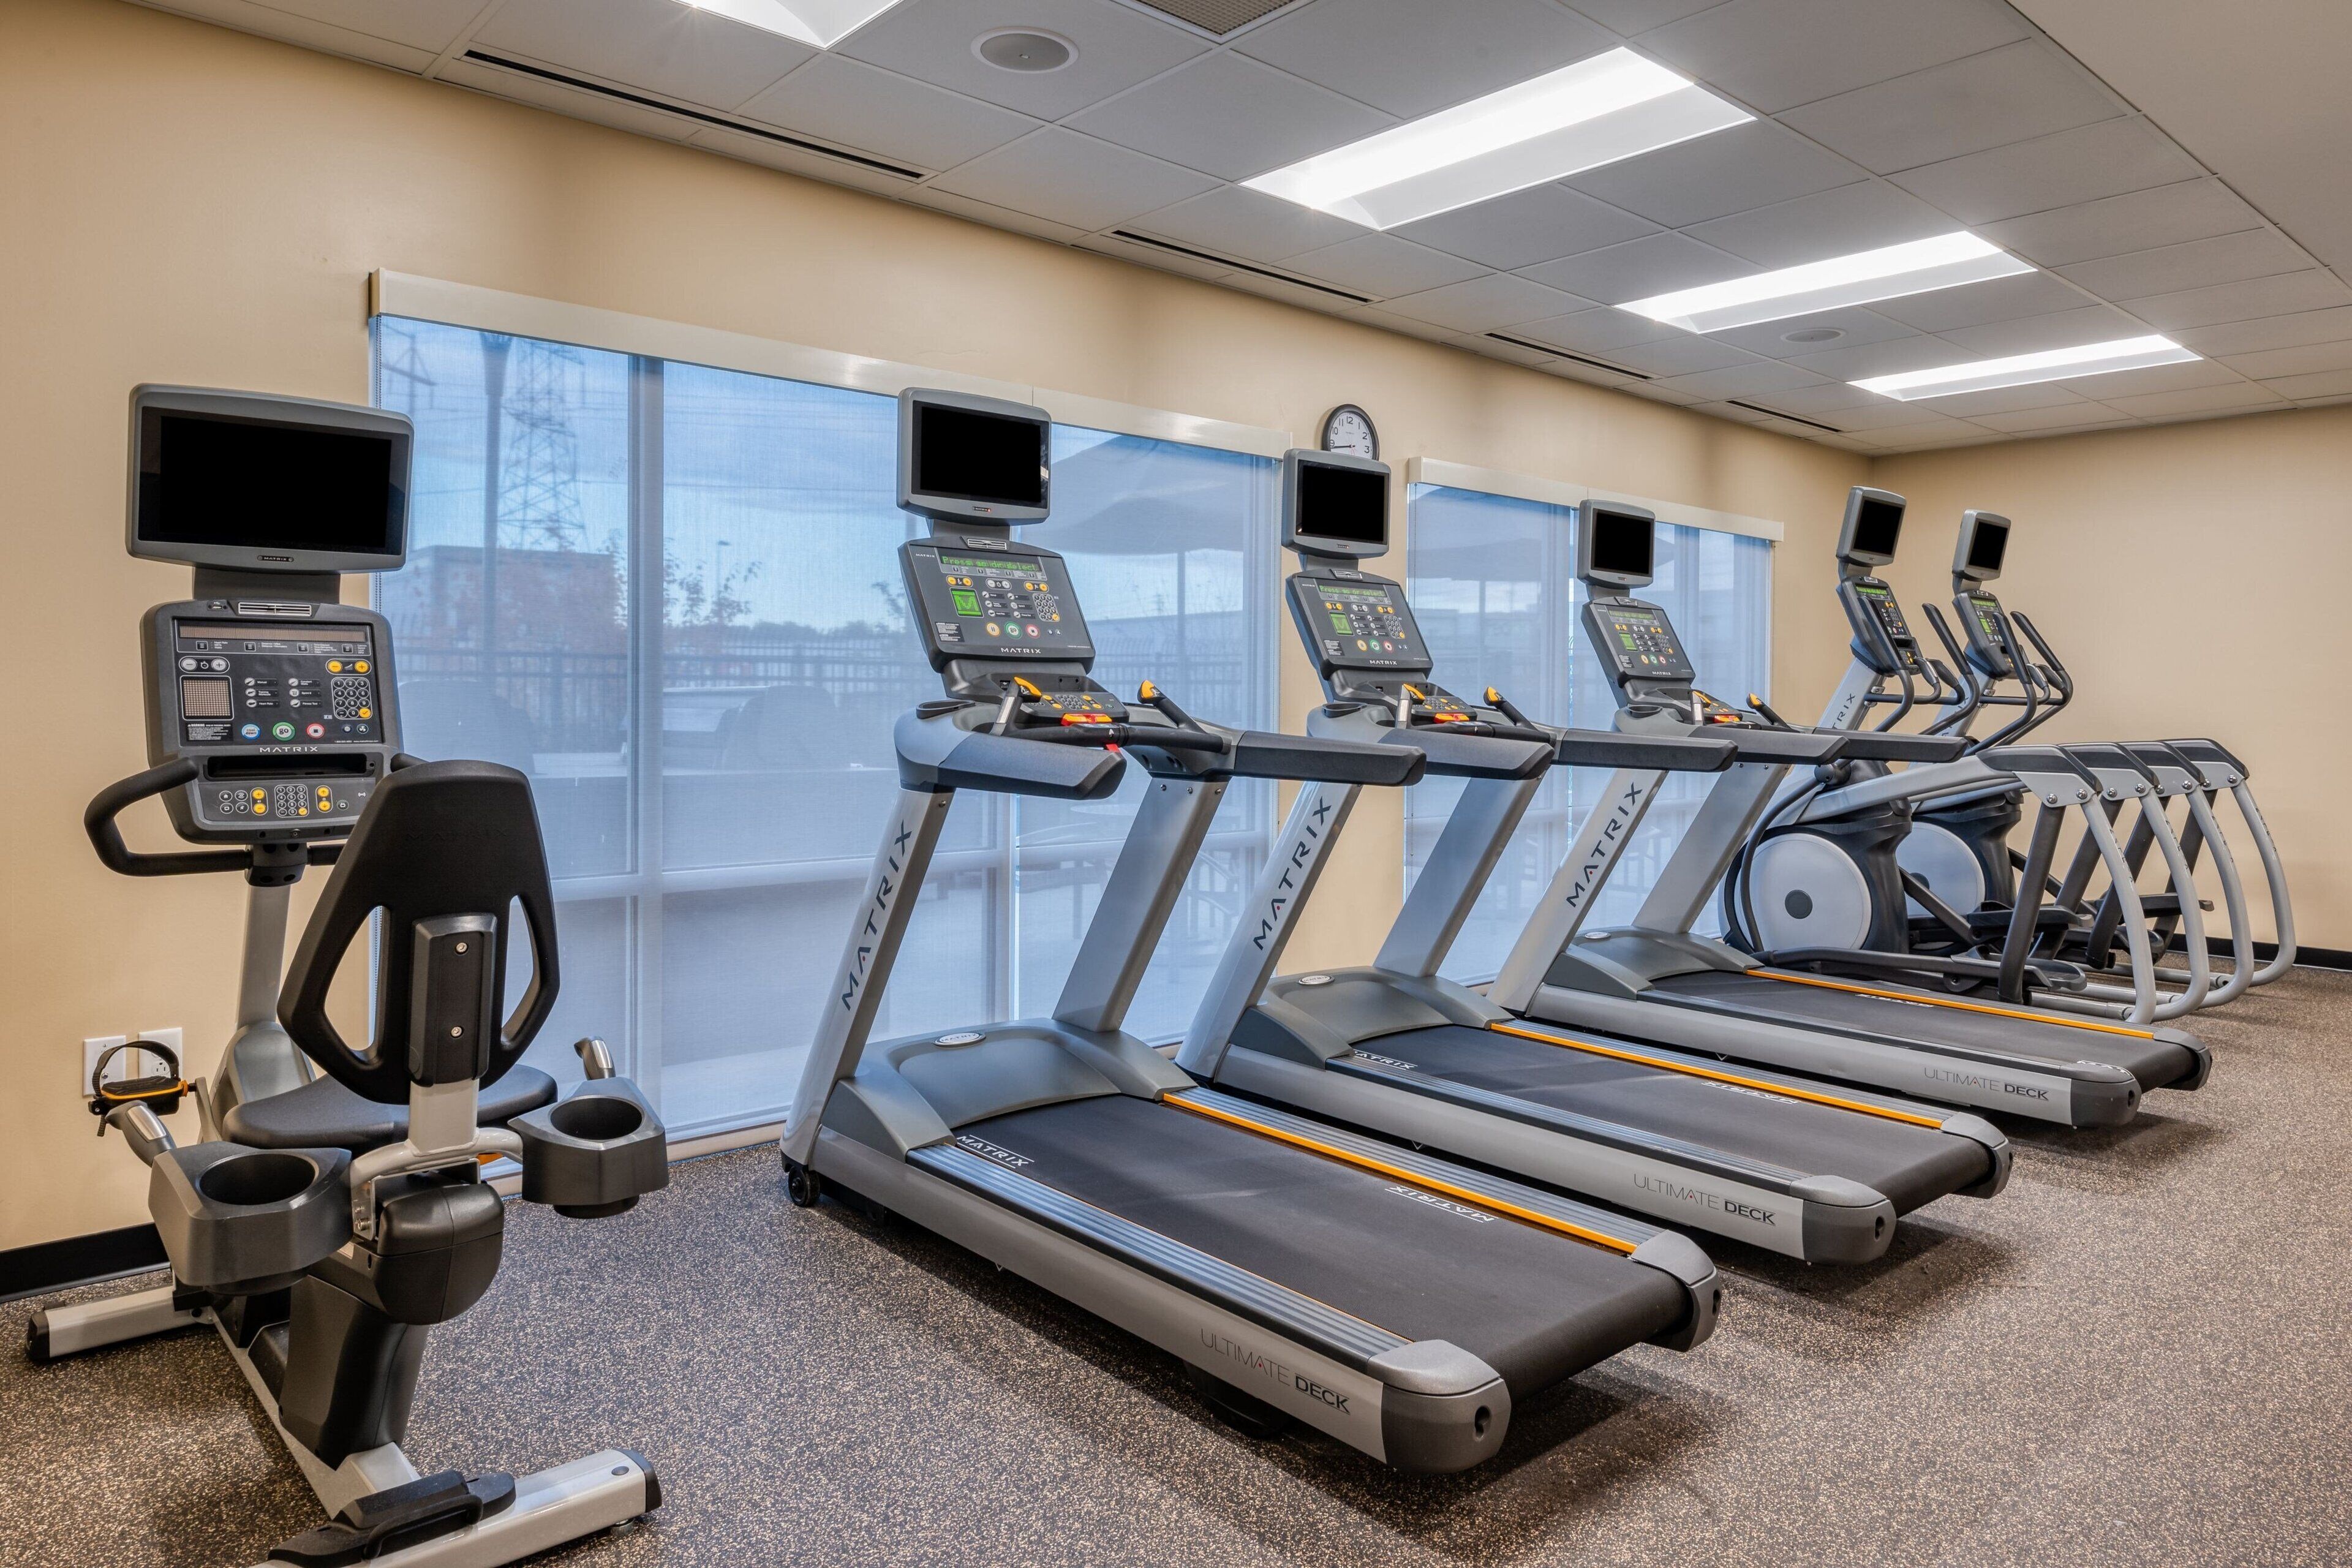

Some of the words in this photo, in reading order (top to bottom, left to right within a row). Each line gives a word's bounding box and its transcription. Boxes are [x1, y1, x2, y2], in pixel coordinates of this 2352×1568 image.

[1332, 426, 1338, 435] 10
[1338, 418, 1344, 426] 11
[1346, 416, 1354, 424] 12
[1566, 782, 1643, 908] MATRIX
[1253, 796, 1332, 951] MATRIX
[842, 819, 912, 1011] MATRIX
[1354, 1051, 1415, 1069] ATRIX
[1924, 1067, 2000, 1092] ULTIMATE
[2004, 1084, 2049, 1101] DECK
[956, 1135, 1029, 1167] MATRIX
[1389, 1186, 1495, 1222] MATRIX
[1634, 1174, 1719, 1210] ULTIMATE
[1724, 1200, 1776, 1226] DECK
[1201, 1328, 1291, 1387] ULTIMATE
[1295, 1374, 1351, 1414] DECK
